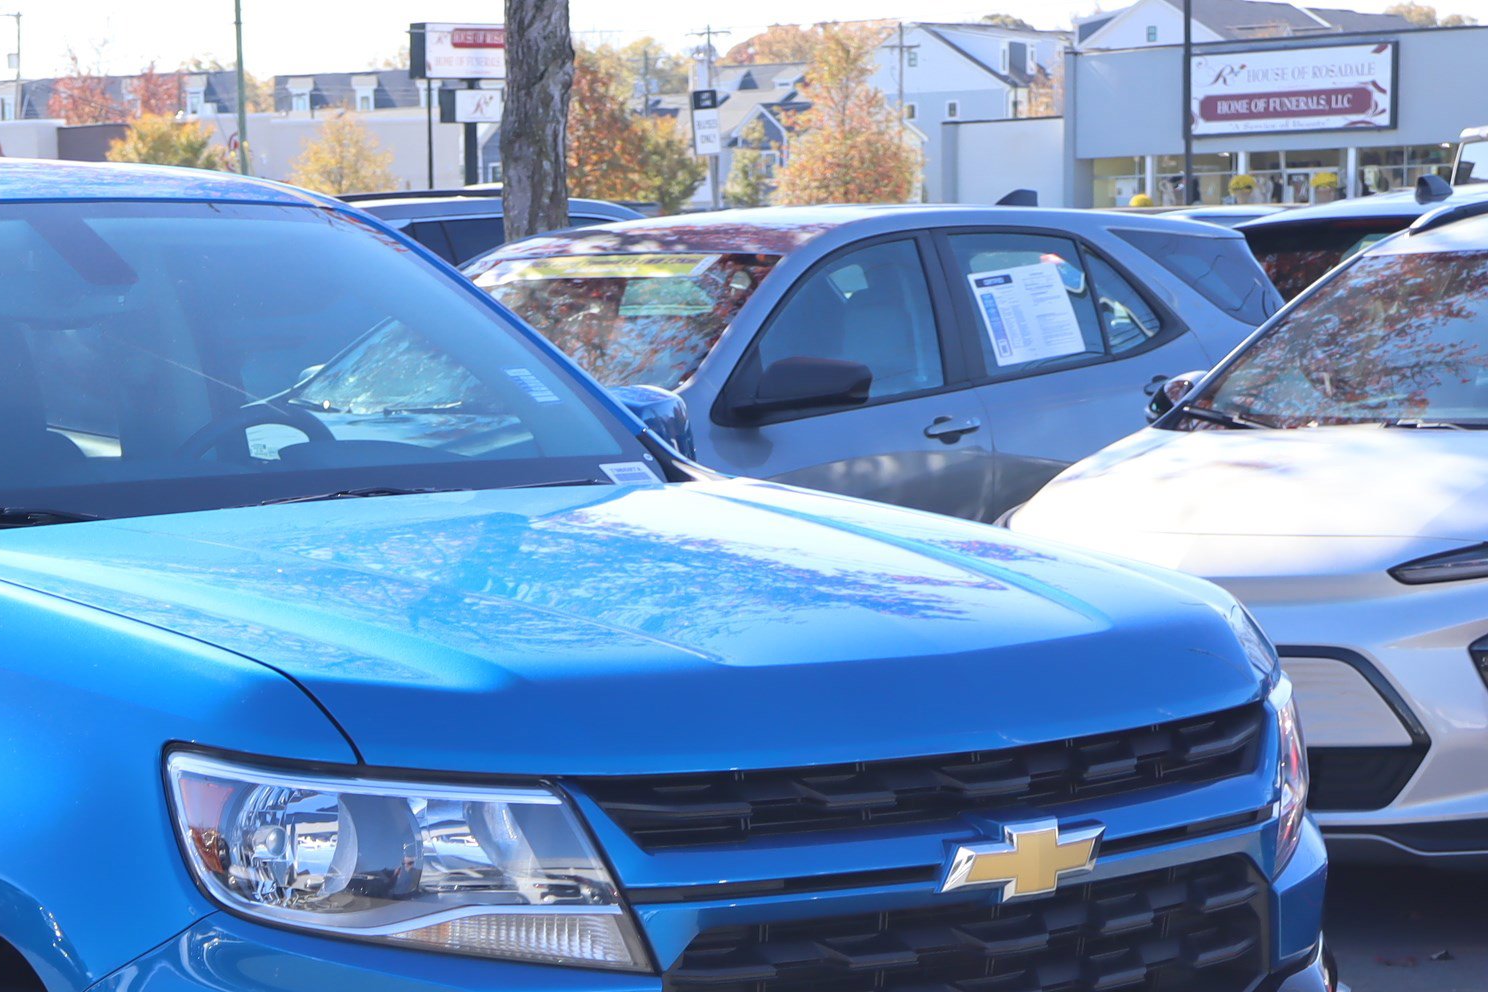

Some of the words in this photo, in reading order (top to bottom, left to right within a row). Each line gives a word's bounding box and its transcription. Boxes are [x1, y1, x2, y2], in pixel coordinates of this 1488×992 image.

[1247, 67, 1289, 83] HOUSE
[1291, 65, 1308, 80] OF
[1311, 62, 1376, 79] ROSADALE
[1216, 99, 1250, 115] HOME
[1251, 98, 1268, 113] OF
[1269, 95, 1330, 112] FUNERALS,
[1331, 93, 1353, 109] LLC
